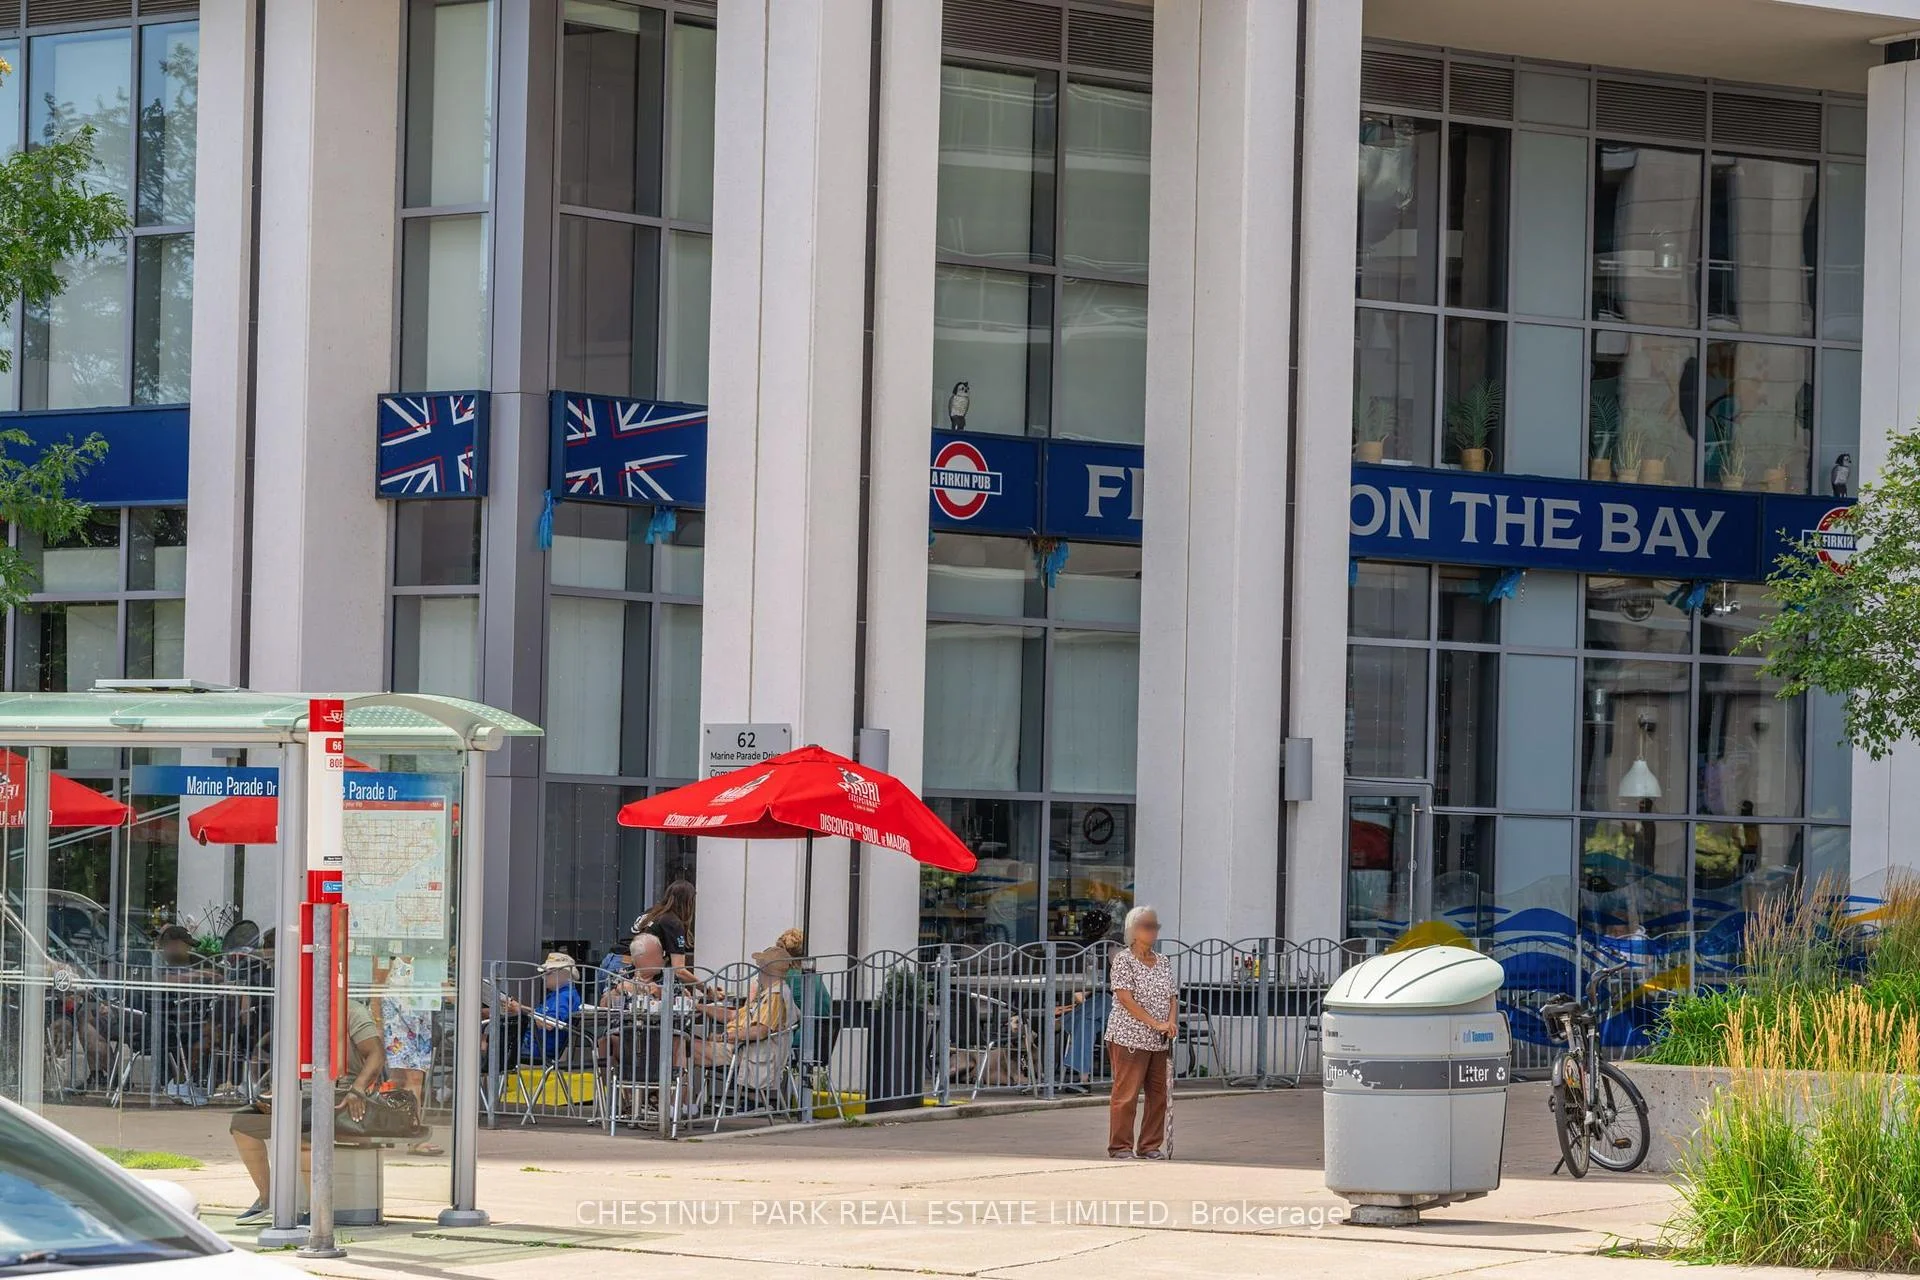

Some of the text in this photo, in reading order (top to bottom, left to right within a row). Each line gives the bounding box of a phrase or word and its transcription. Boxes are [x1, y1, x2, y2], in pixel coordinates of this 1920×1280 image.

[931, 471, 991, 490] A FIRKIN PUB
[1350, 484, 1432, 540] ON
[1450, 491, 1583, 550] THE
[1600, 502, 1726, 559] BAY
[332, 740, 342, 751] 66
[737, 731, 756, 748] 62
[710, 751, 734, 760] Marine
[736, 751, 761, 760] Parade
[186, 775, 277, 796] Marine Parade Dr
[349, 780, 385, 800] Parade
[388, 785, 398, 800] Dr
[819, 813, 855, 838] DISCOVER
[862, 825, 881, 845] SOUL
[1458, 1064, 1490, 1083] Litter
